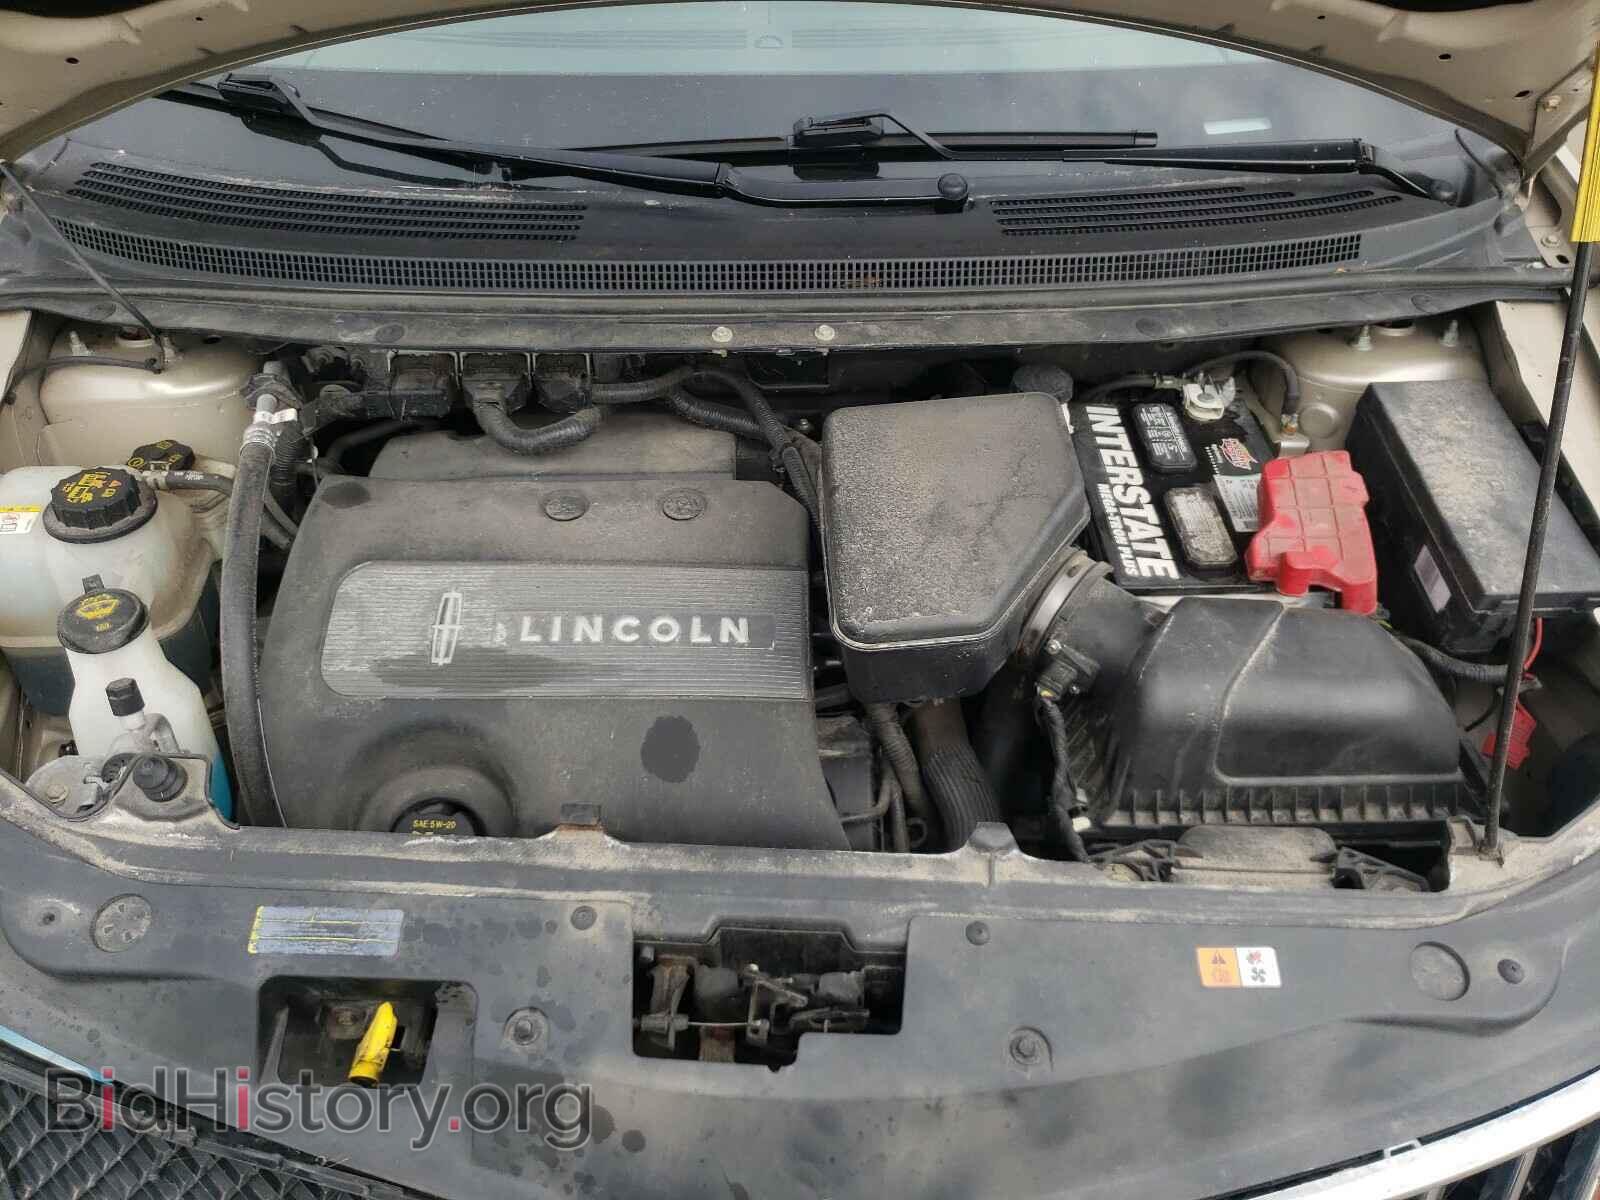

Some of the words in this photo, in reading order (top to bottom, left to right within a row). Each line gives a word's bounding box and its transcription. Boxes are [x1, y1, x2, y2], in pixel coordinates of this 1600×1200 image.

[1085, 406, 1179, 579] INTERSTATE
[1096, 483, 1129, 545] MEGA-TRON
[1117, 546, 1139, 577] PLUS
[520, 614, 751, 645] LINCOLN
[413, 819, 429, 828] SAE
[430, 820, 457, 829] 5W-20
